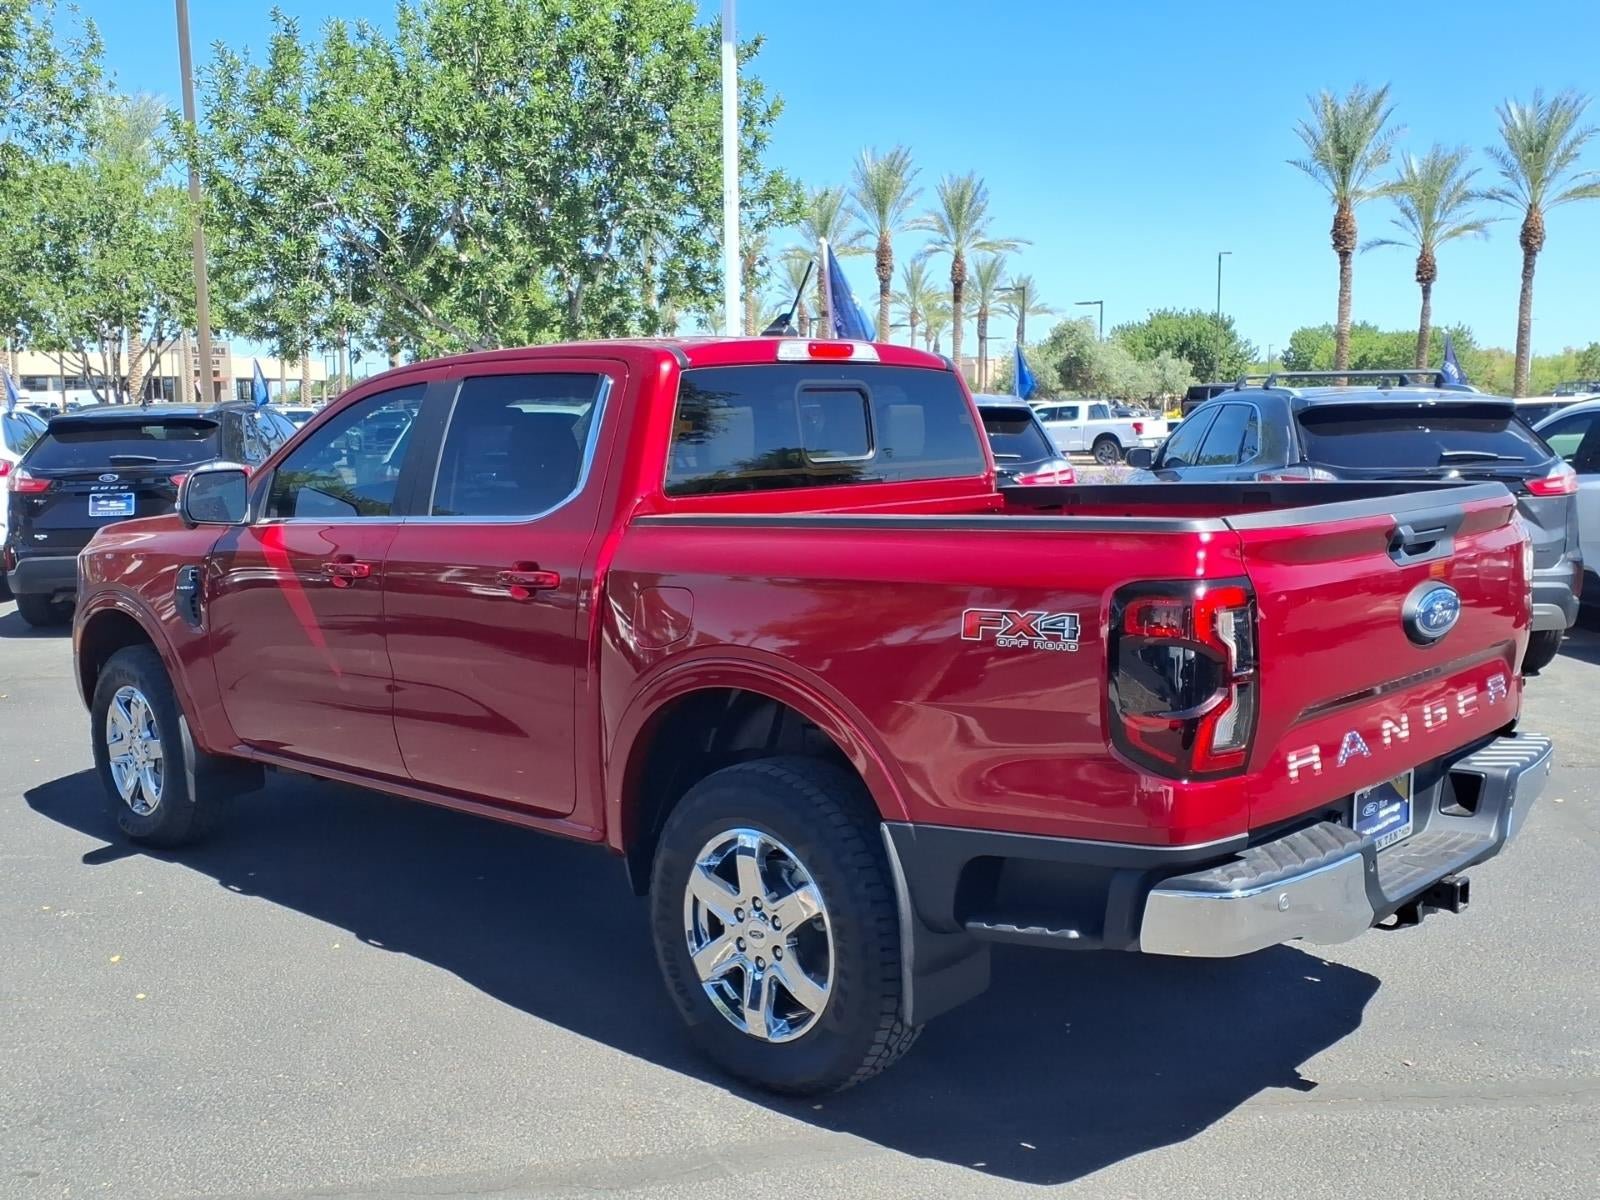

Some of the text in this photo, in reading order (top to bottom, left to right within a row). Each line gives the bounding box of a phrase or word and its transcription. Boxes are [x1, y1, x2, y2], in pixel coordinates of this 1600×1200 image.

[961, 608, 1080, 642] FX4
[996, 638, 1079, 652] OFF ROAD
[1287, 672, 1507, 784] RANGER
